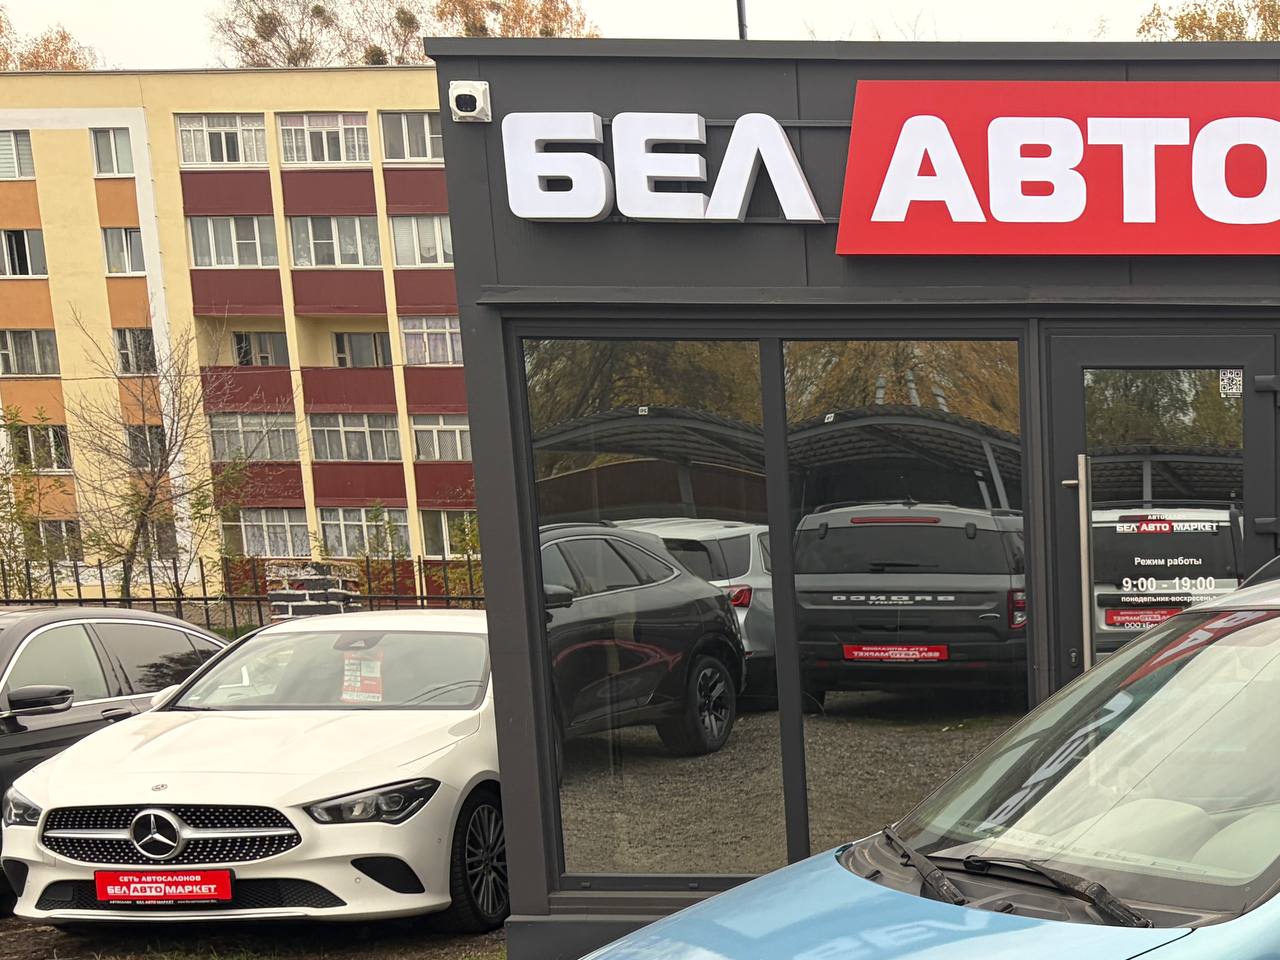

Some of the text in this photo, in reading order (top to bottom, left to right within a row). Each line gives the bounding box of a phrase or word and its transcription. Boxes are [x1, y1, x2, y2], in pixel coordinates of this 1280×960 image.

[502, 111, 825, 224] БЕЛ
[1116, 522, 1218, 532] БЕЛ АВТО МАРКЕТ
[1134, 557, 1202, 567] Режим работы
[1122, 577, 1156, 592] 9:00
[1173, 577, 1215, 591] 19:00
[107, 884, 217, 894] БЕЛ АВТО МАРКЕТ
